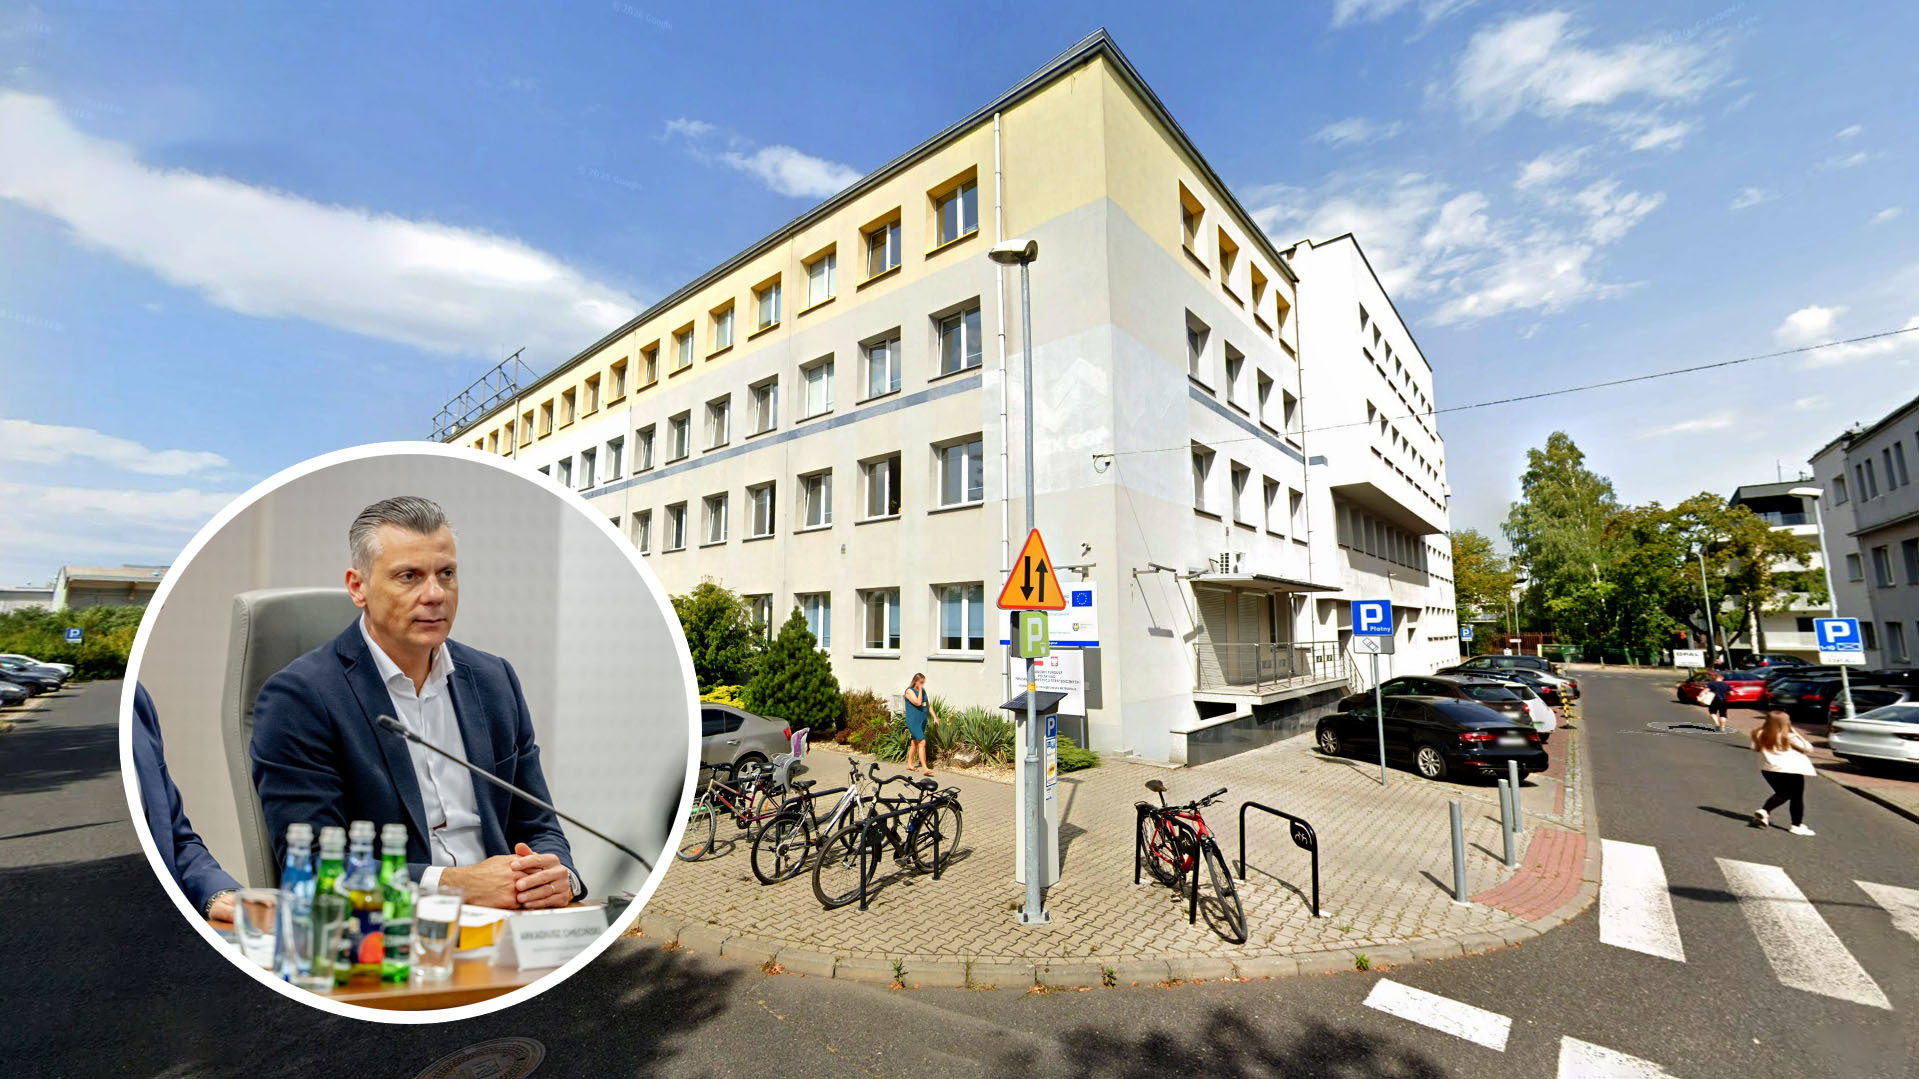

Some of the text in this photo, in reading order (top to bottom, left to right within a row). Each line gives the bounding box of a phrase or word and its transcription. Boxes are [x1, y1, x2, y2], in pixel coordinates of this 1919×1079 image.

[1360, 604, 1383, 631] P
[1027, 617, 1043, 653] P
[1824, 621, 1851, 643] P
[1047, 718, 1055, 737] P
